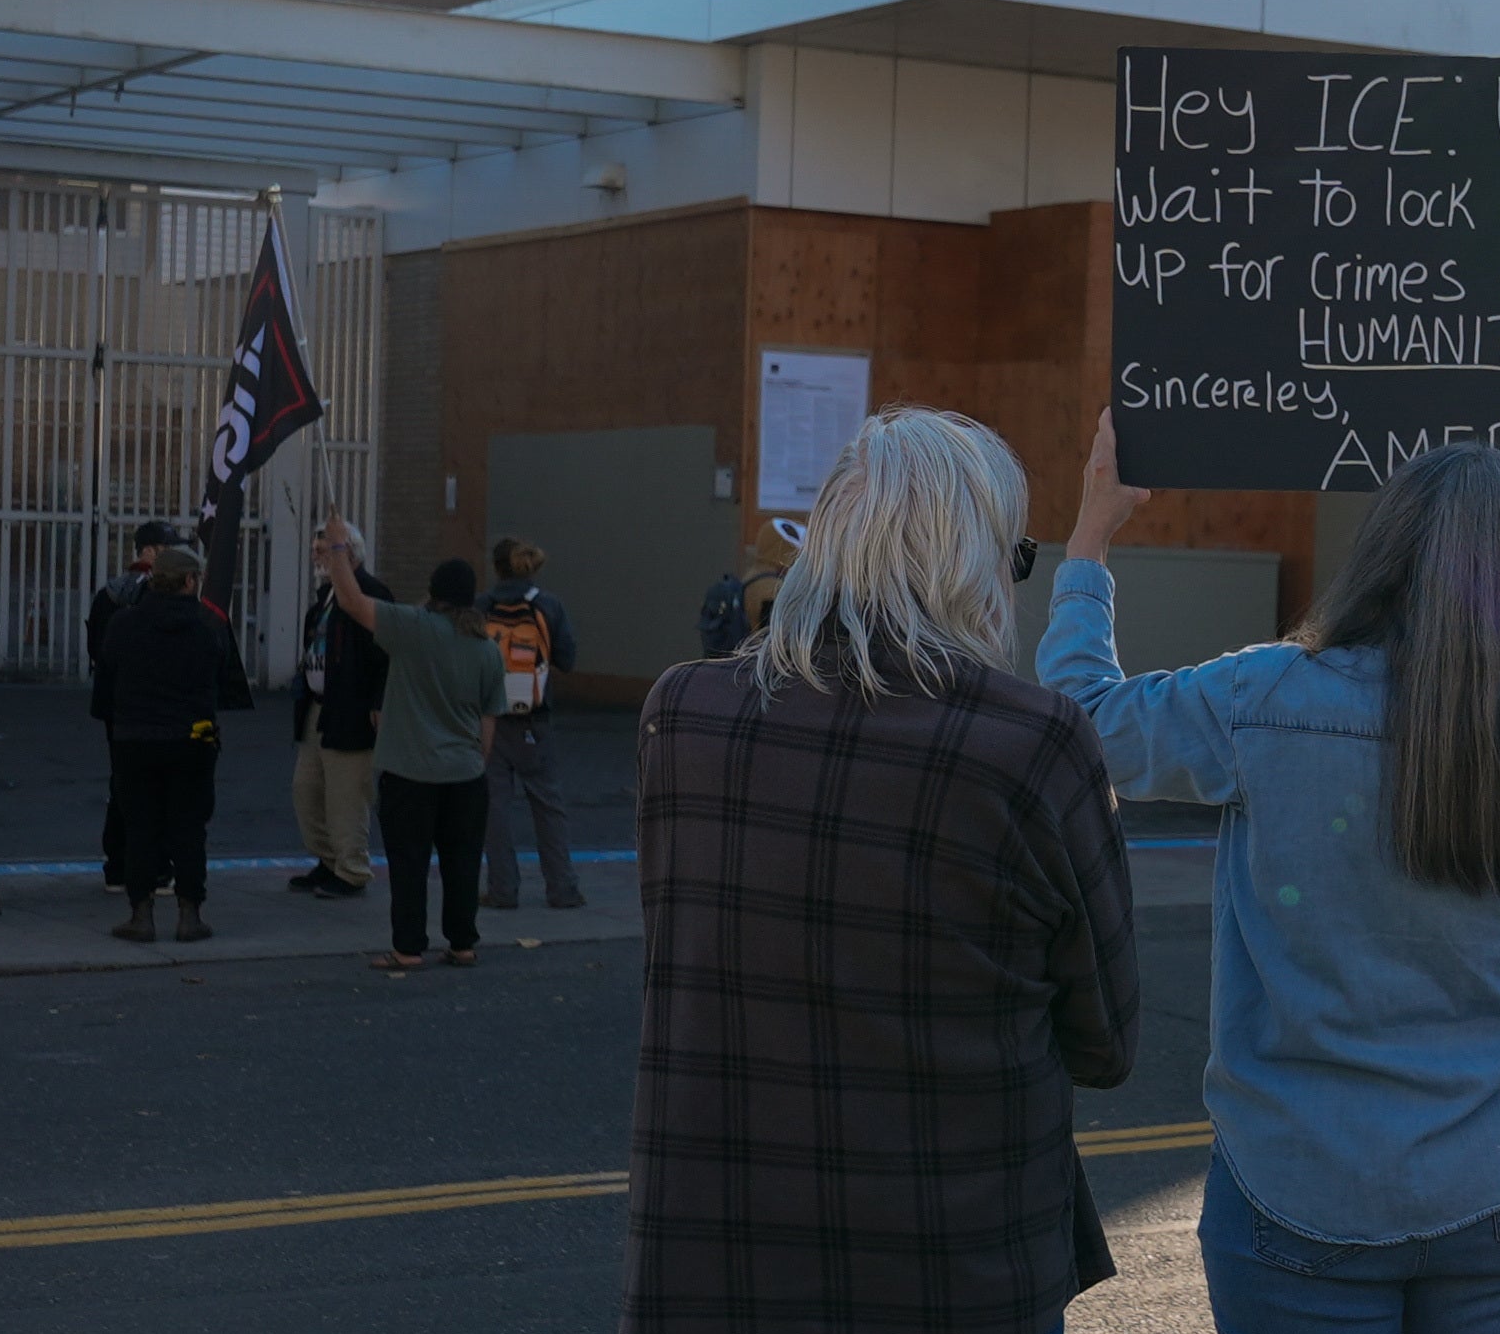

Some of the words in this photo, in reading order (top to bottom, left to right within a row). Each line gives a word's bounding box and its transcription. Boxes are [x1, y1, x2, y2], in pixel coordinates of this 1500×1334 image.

[1124, 55, 1255, 154] Hey
[1116, 167, 1273, 227] Wait
[1300, 168, 1357, 228] to
[1386, 166, 1476, 230] lock
[1208, 242, 1284, 301] for
